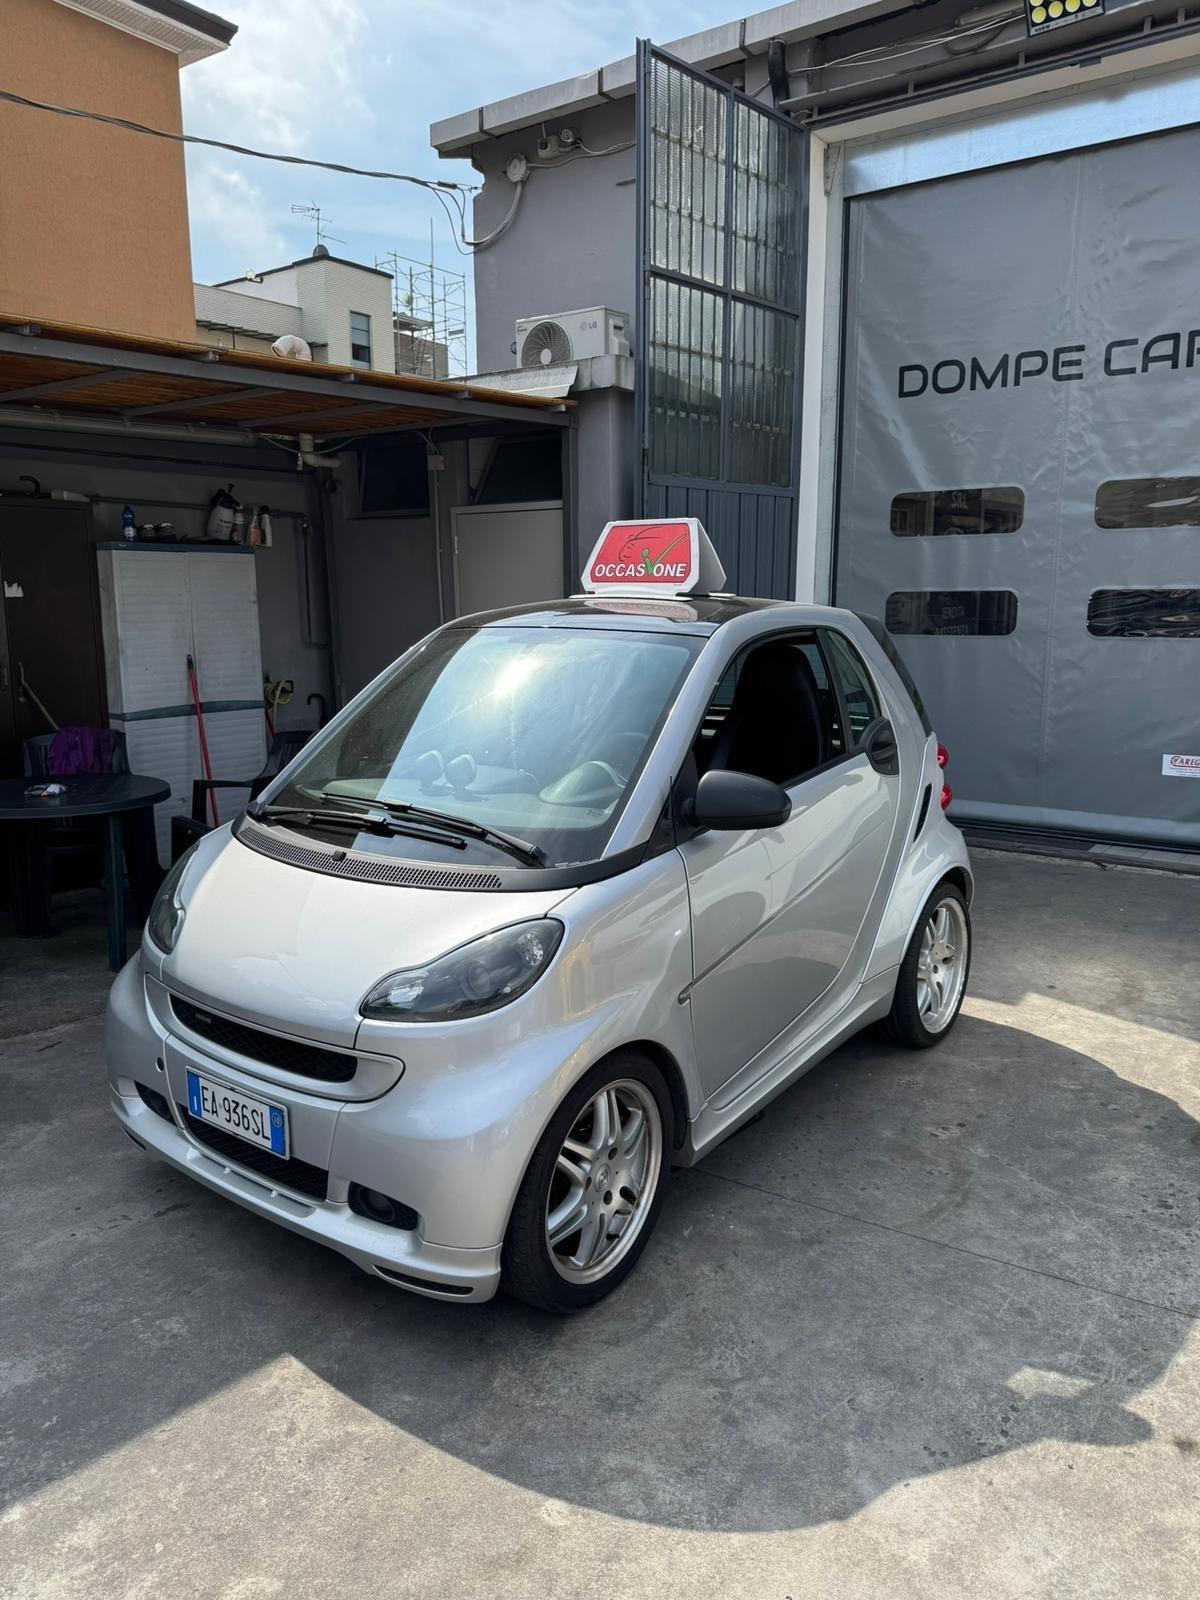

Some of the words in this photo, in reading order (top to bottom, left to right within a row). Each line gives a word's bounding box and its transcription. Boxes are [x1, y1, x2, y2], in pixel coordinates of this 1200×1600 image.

[898, 344, 1086, 398] DOMPE
[201, 1085, 219, 1118] EA
[222, 1096, 271, 1141] 936SL
